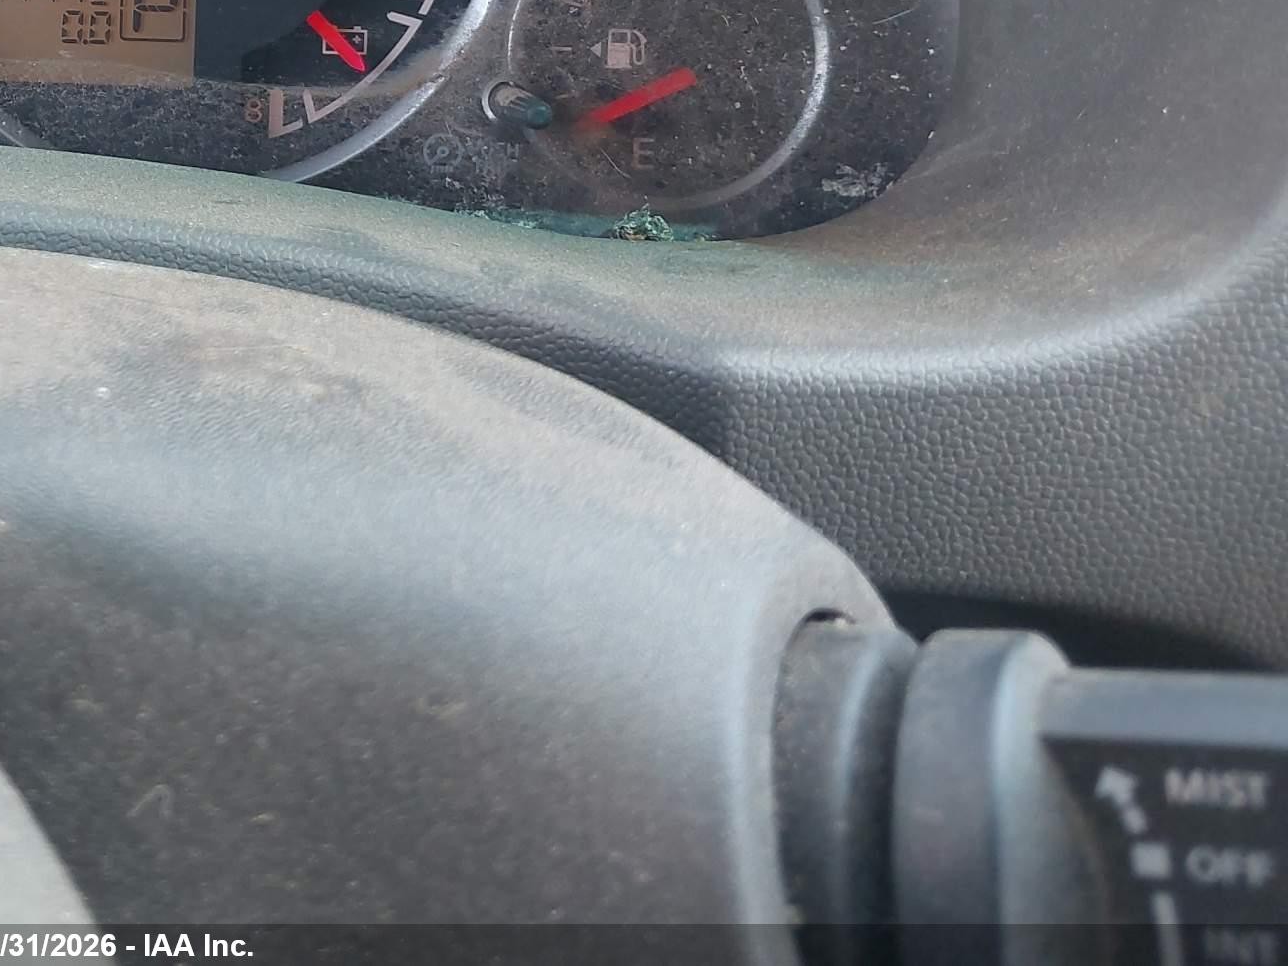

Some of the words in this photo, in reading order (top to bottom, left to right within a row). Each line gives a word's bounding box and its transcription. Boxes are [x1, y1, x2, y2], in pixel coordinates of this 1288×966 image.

[245, 99, 264, 123] 8
[632, 137, 655, 170] E
[1164, 769, 1268, 807] MIST
[1185, 847, 1272, 885] OFF
